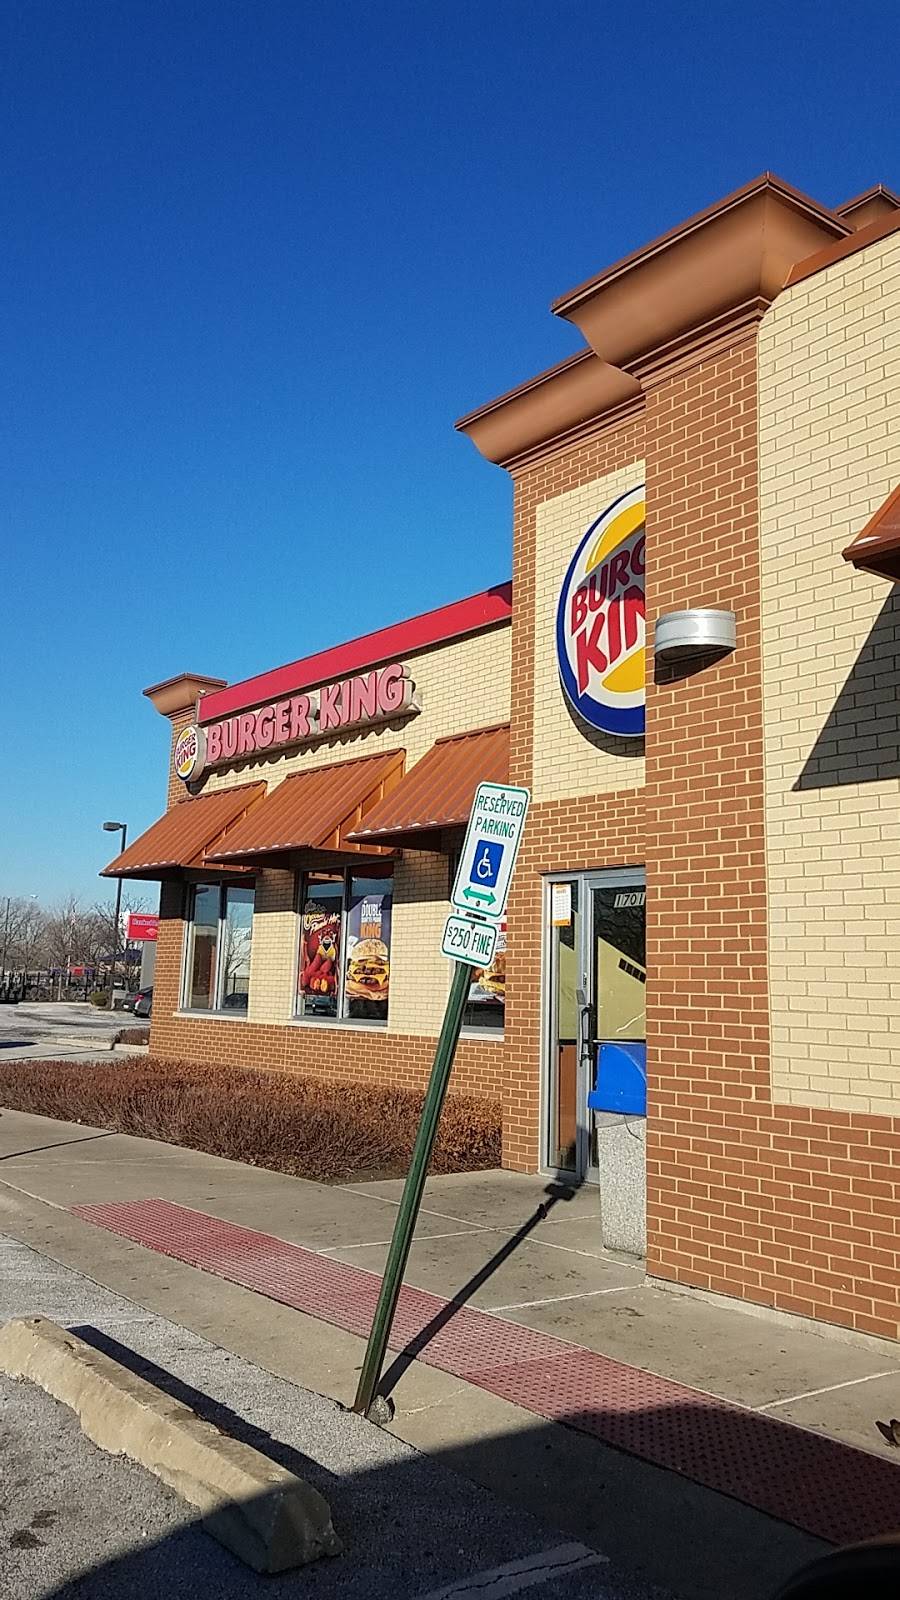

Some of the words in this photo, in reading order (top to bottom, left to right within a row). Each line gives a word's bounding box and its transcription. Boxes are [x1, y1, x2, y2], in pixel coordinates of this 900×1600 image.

[571, 534, 645, 636] BURG
[576, 585, 645, 694] KIN
[208, 695, 311, 763] BURGER
[319, 664, 405, 731] KING
[175, 742, 196, 768] KING
[477, 795, 524, 817] RESERVED
[474, 816, 516, 839] PARKING
[360, 922, 382, 939] KING
[447, 925, 470, 949] $250
[471, 932, 493, 956] FINE
